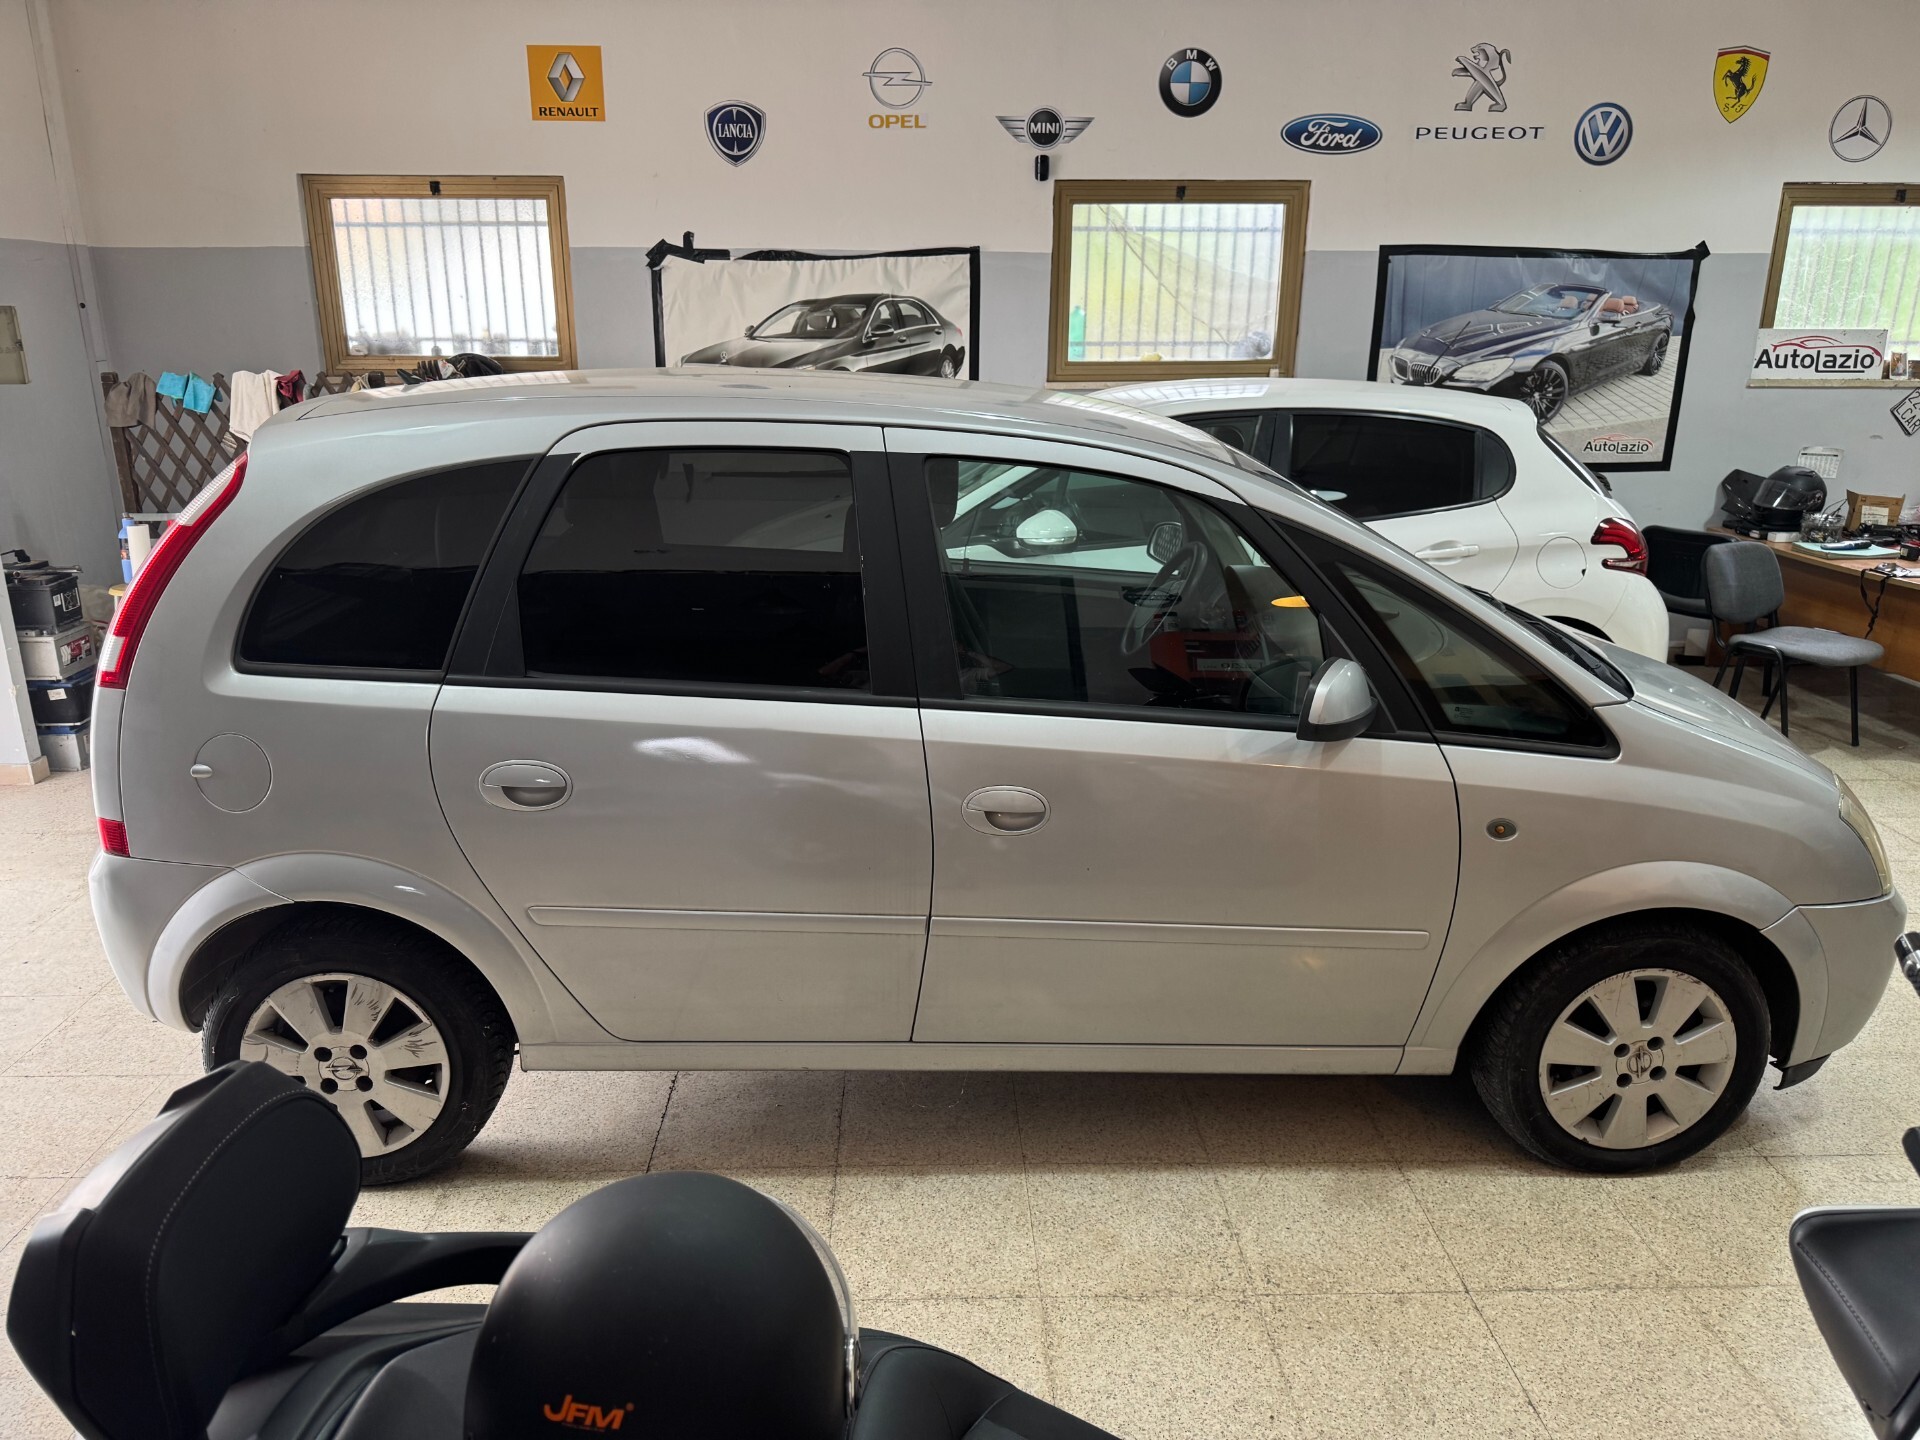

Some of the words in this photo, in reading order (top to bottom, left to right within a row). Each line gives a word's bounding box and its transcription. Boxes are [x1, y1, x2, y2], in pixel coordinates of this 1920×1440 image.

[1166, 49, 1217, 71] BMW
[538, 106, 599, 118] RENAULT
[868, 114, 926, 129] OPEL
[1030, 121, 1060, 135] MINI
[718, 123, 754, 139] LANCIA
[1300, 120, 1364, 149] Ford
[1415, 126, 1544, 140] PEUGEOT
[543, 1394, 625, 1430] JFM
